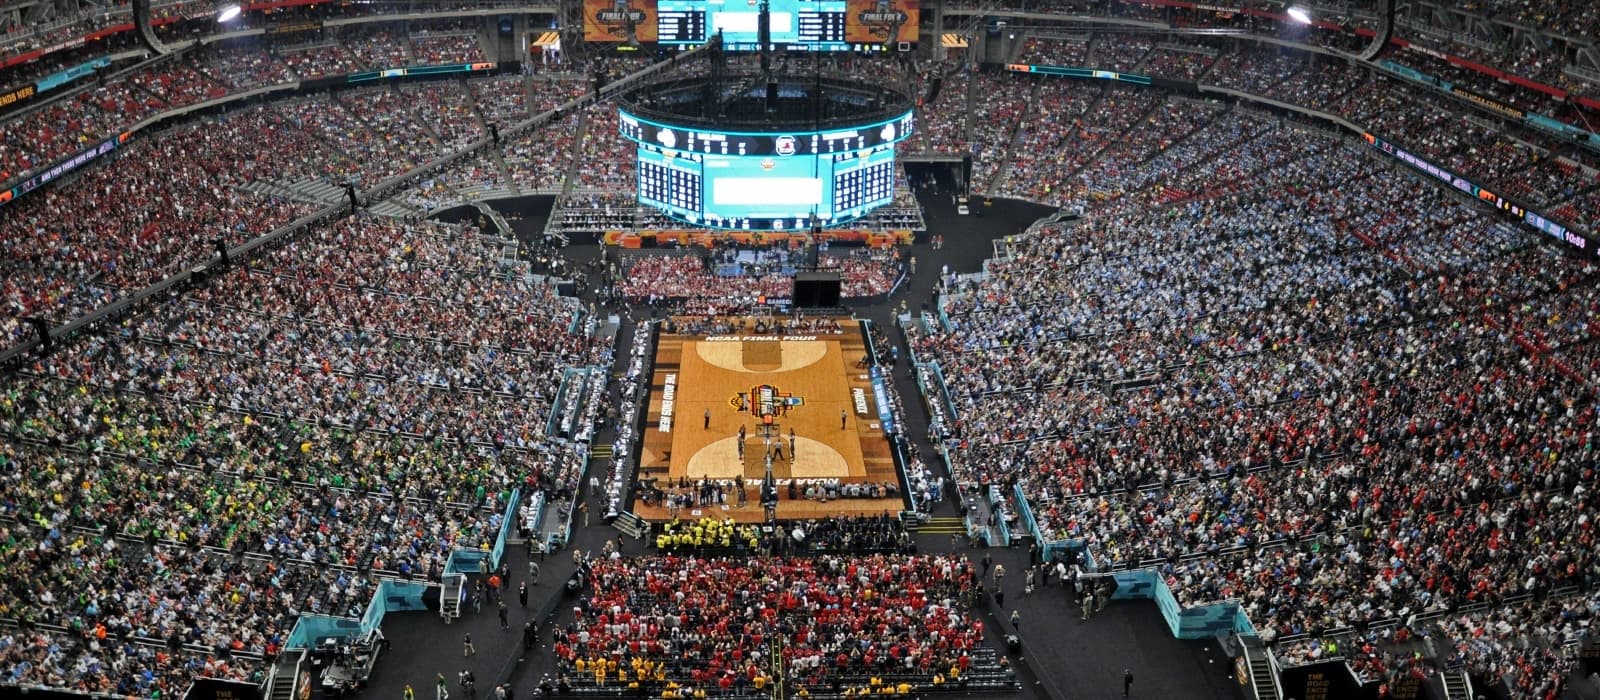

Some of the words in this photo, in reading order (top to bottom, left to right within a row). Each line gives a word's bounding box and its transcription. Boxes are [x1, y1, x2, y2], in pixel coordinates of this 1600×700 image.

[602, 12, 621, 20] FINAL
[864, 13, 882, 21] FINAL
[17, 86, 34, 99] HERE
[664, 373, 676, 384] THE
[662, 384, 676, 400] ROAD
[661, 400, 673, 416] ENDS
[852, 387, 868, 415] PHOENIX
[658, 416, 671, 433] HERE
